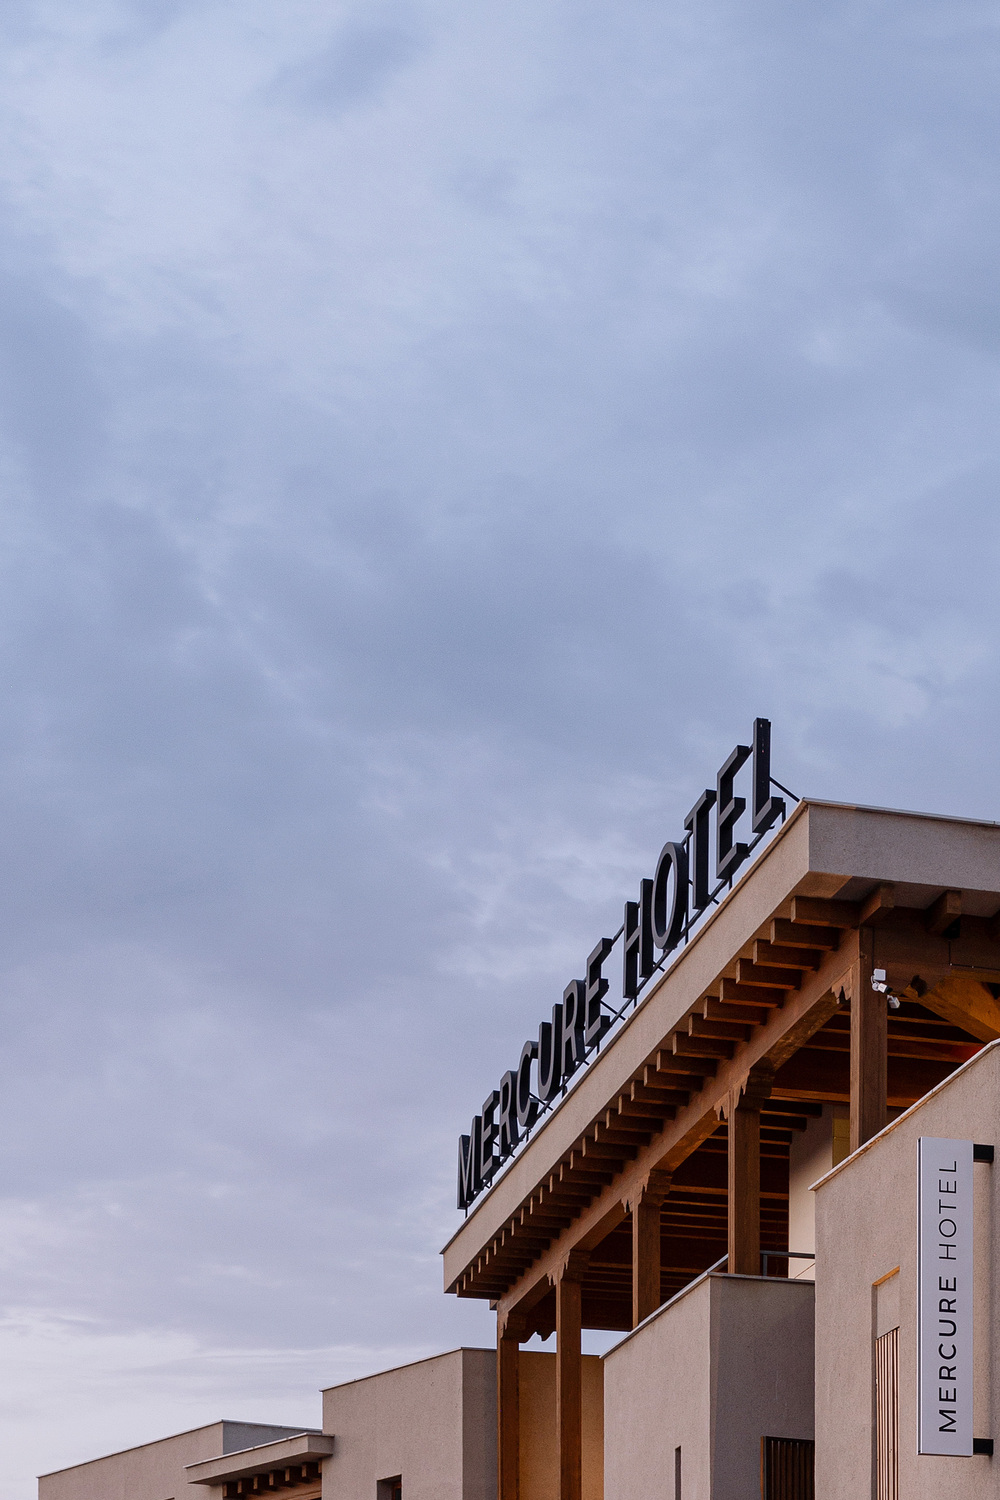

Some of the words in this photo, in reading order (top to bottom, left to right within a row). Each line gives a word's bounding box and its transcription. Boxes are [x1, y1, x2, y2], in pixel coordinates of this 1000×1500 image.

[457, 938, 611, 1210] MERCURE
[623, 718, 785, 999] HOTEL
[938, 1160, 957, 1261] HOTEL
[938, 1276, 957, 1433] MERCURE
